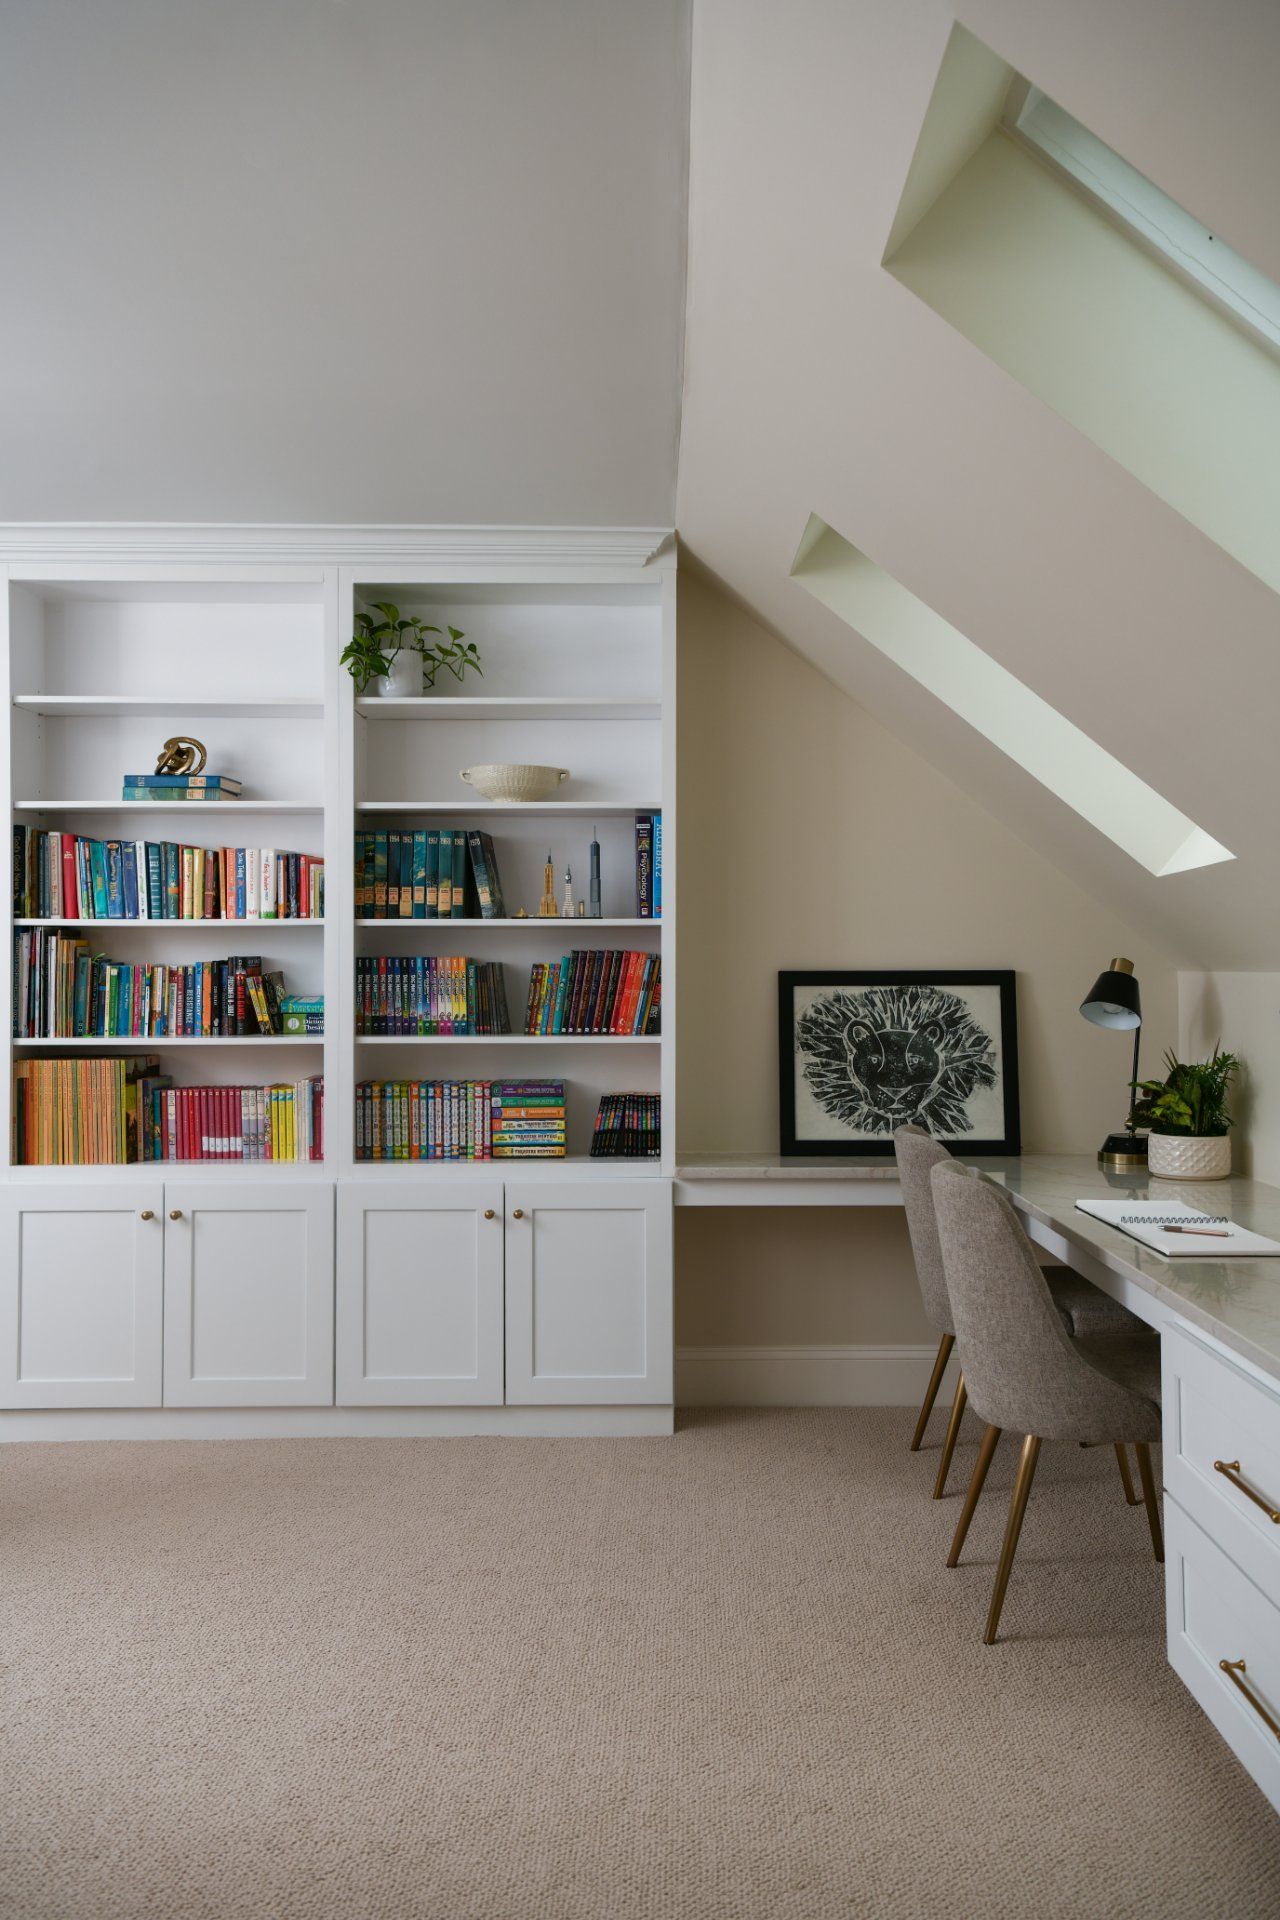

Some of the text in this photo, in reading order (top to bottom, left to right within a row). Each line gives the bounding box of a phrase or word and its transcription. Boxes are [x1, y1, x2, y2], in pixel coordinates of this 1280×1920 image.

[640, 853, 648, 900] Psychology
[186, 989, 194, 1024] RESISTANCE
[237, 1001, 245, 1020] GAMES
